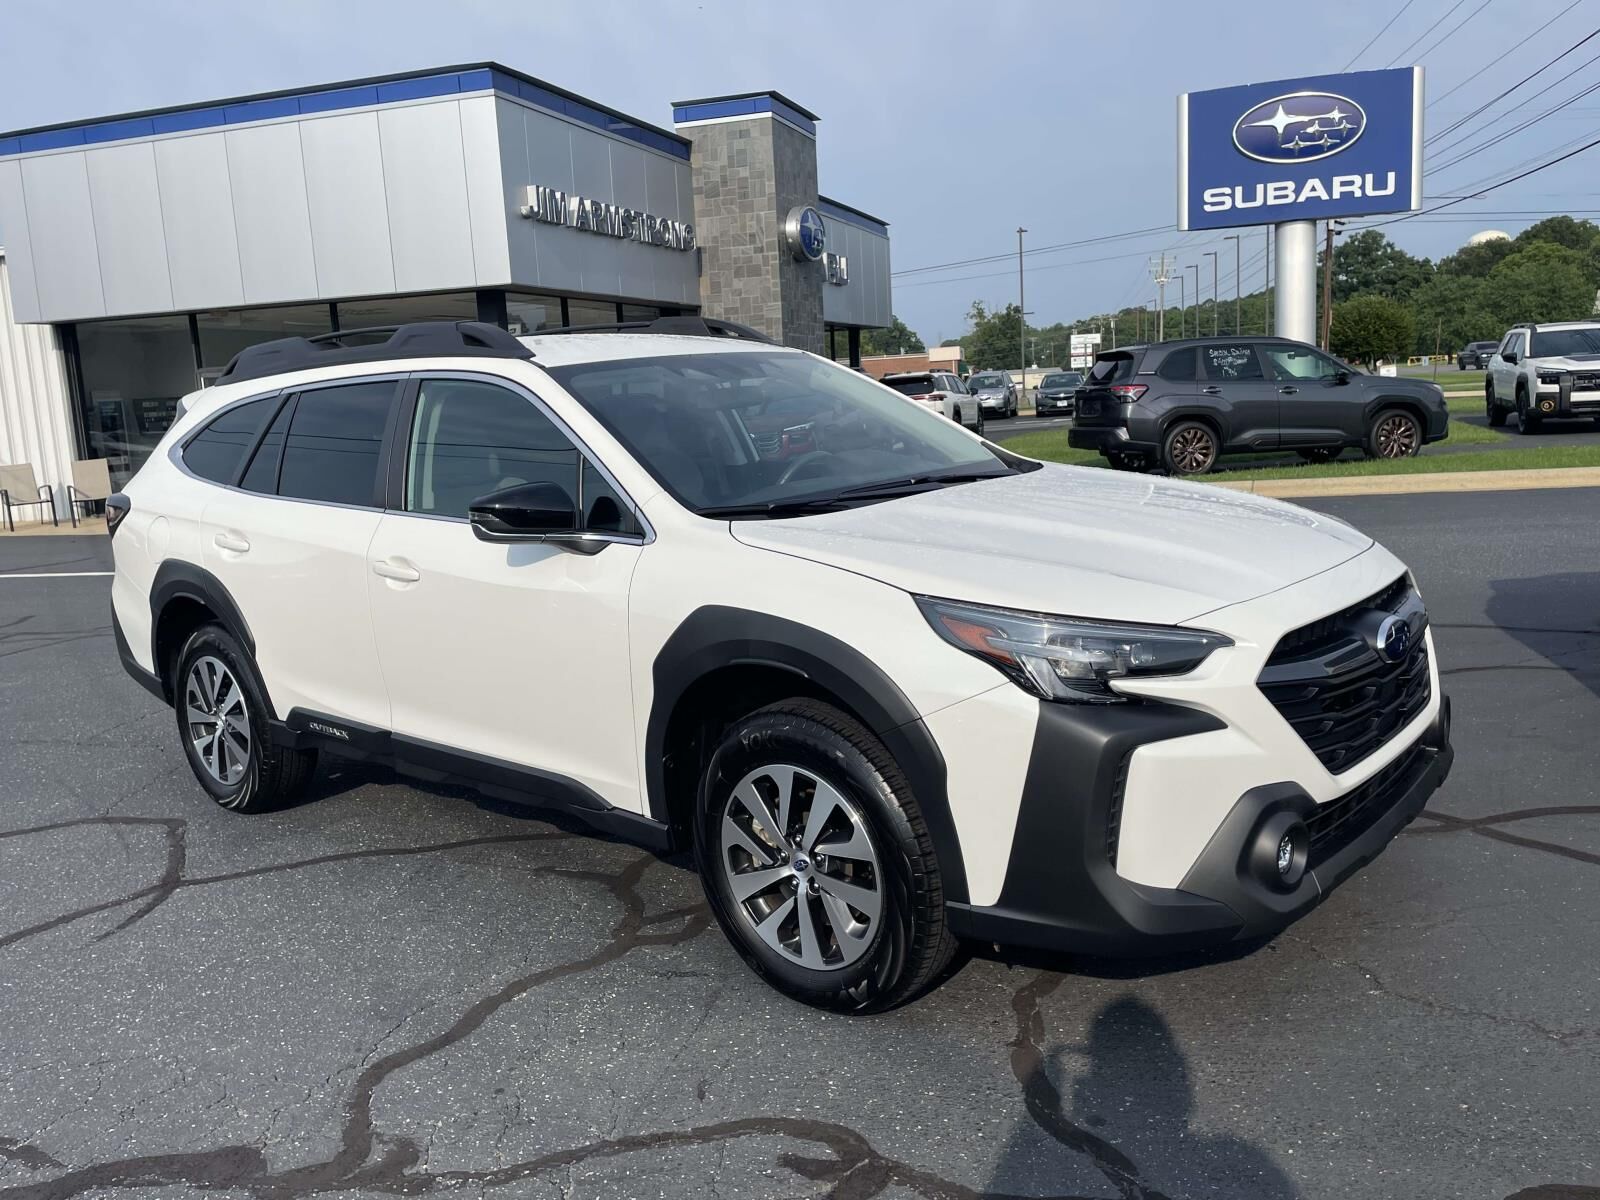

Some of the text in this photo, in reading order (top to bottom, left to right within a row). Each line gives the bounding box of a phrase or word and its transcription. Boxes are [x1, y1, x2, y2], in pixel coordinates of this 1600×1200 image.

[1203, 171, 1396, 213] SUBARU
[520, 185, 697, 251] JIM ARMSTRONG
[309, 722, 350, 740] OUTBACK
